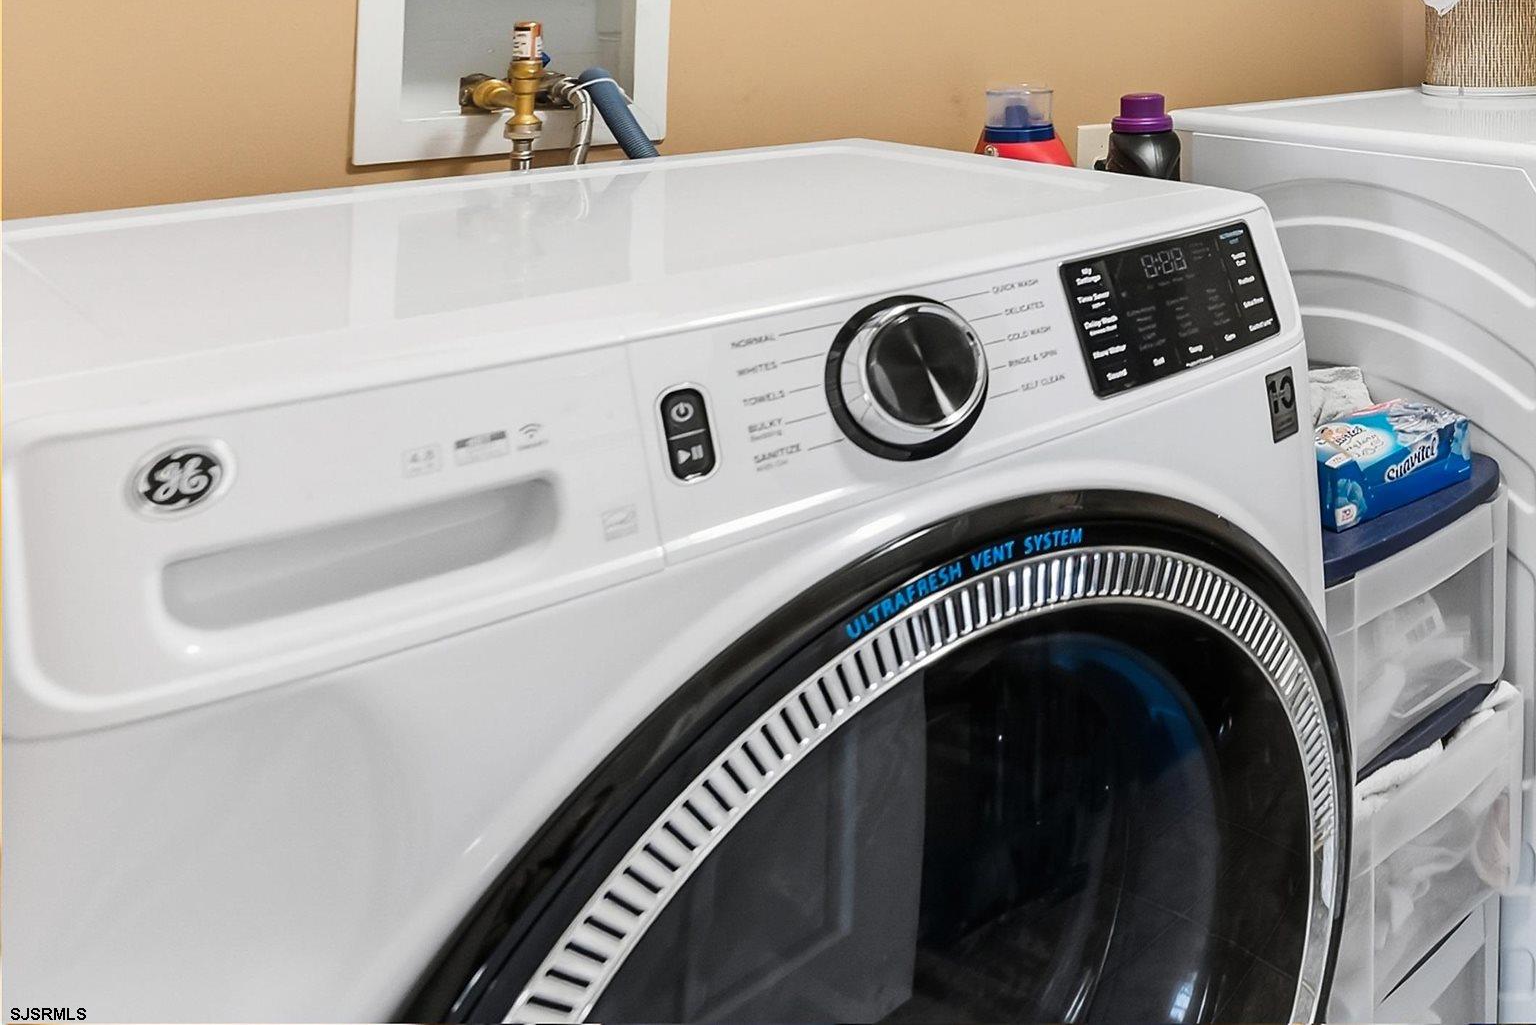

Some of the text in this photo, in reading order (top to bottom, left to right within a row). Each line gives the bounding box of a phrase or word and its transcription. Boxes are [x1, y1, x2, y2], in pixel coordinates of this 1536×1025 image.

[730, 334, 776, 349] NORMAL
[736, 360, 778, 376] WHITES
[742, 389, 786, 406] TOWELS
[753, 442, 802, 465] SANITIZE
[1385, 435, 1438, 482] Suavitel
[845, 527, 1083, 640] ULTRAFRESH VENT SYSTEM
